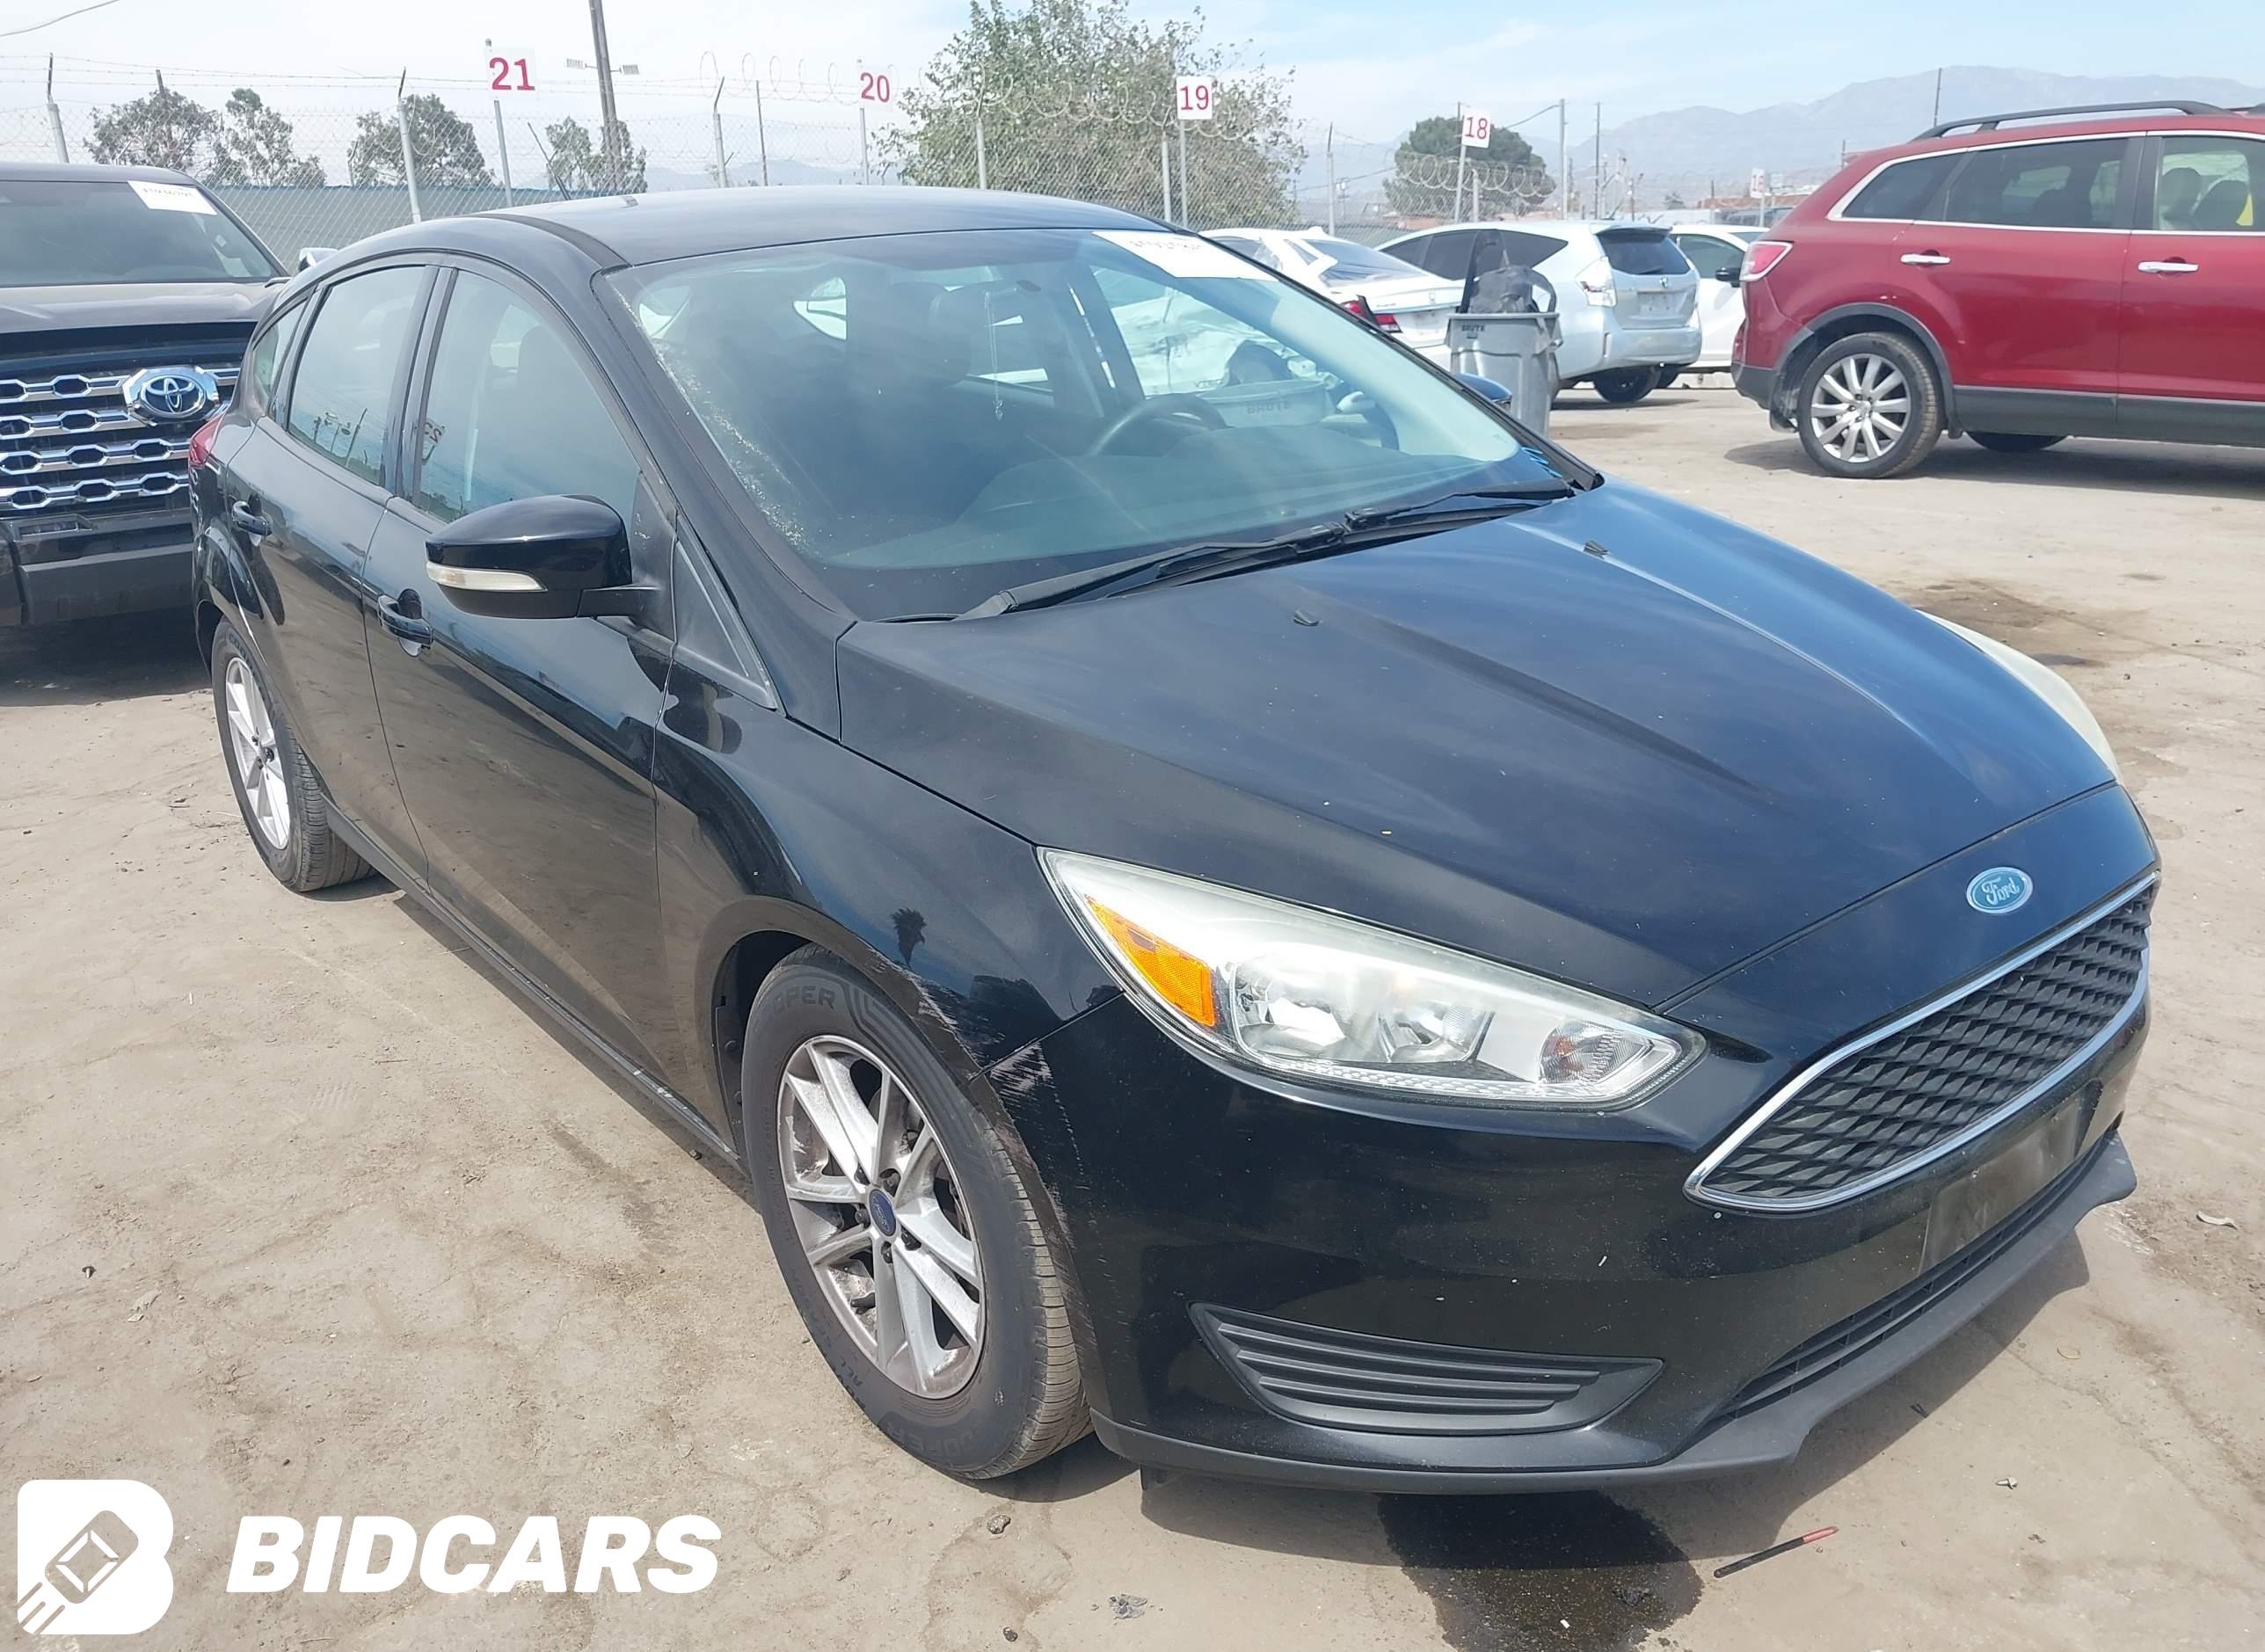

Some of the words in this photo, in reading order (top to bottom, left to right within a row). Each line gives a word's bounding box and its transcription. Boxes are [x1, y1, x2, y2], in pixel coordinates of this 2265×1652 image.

[489, 56, 535, 91] 21
[860, 72, 890, 103] 20
[1180, 84, 1209, 110] 19
[1464, 116, 1488, 140] 18
[1981, 877, 2020, 906] Ford
